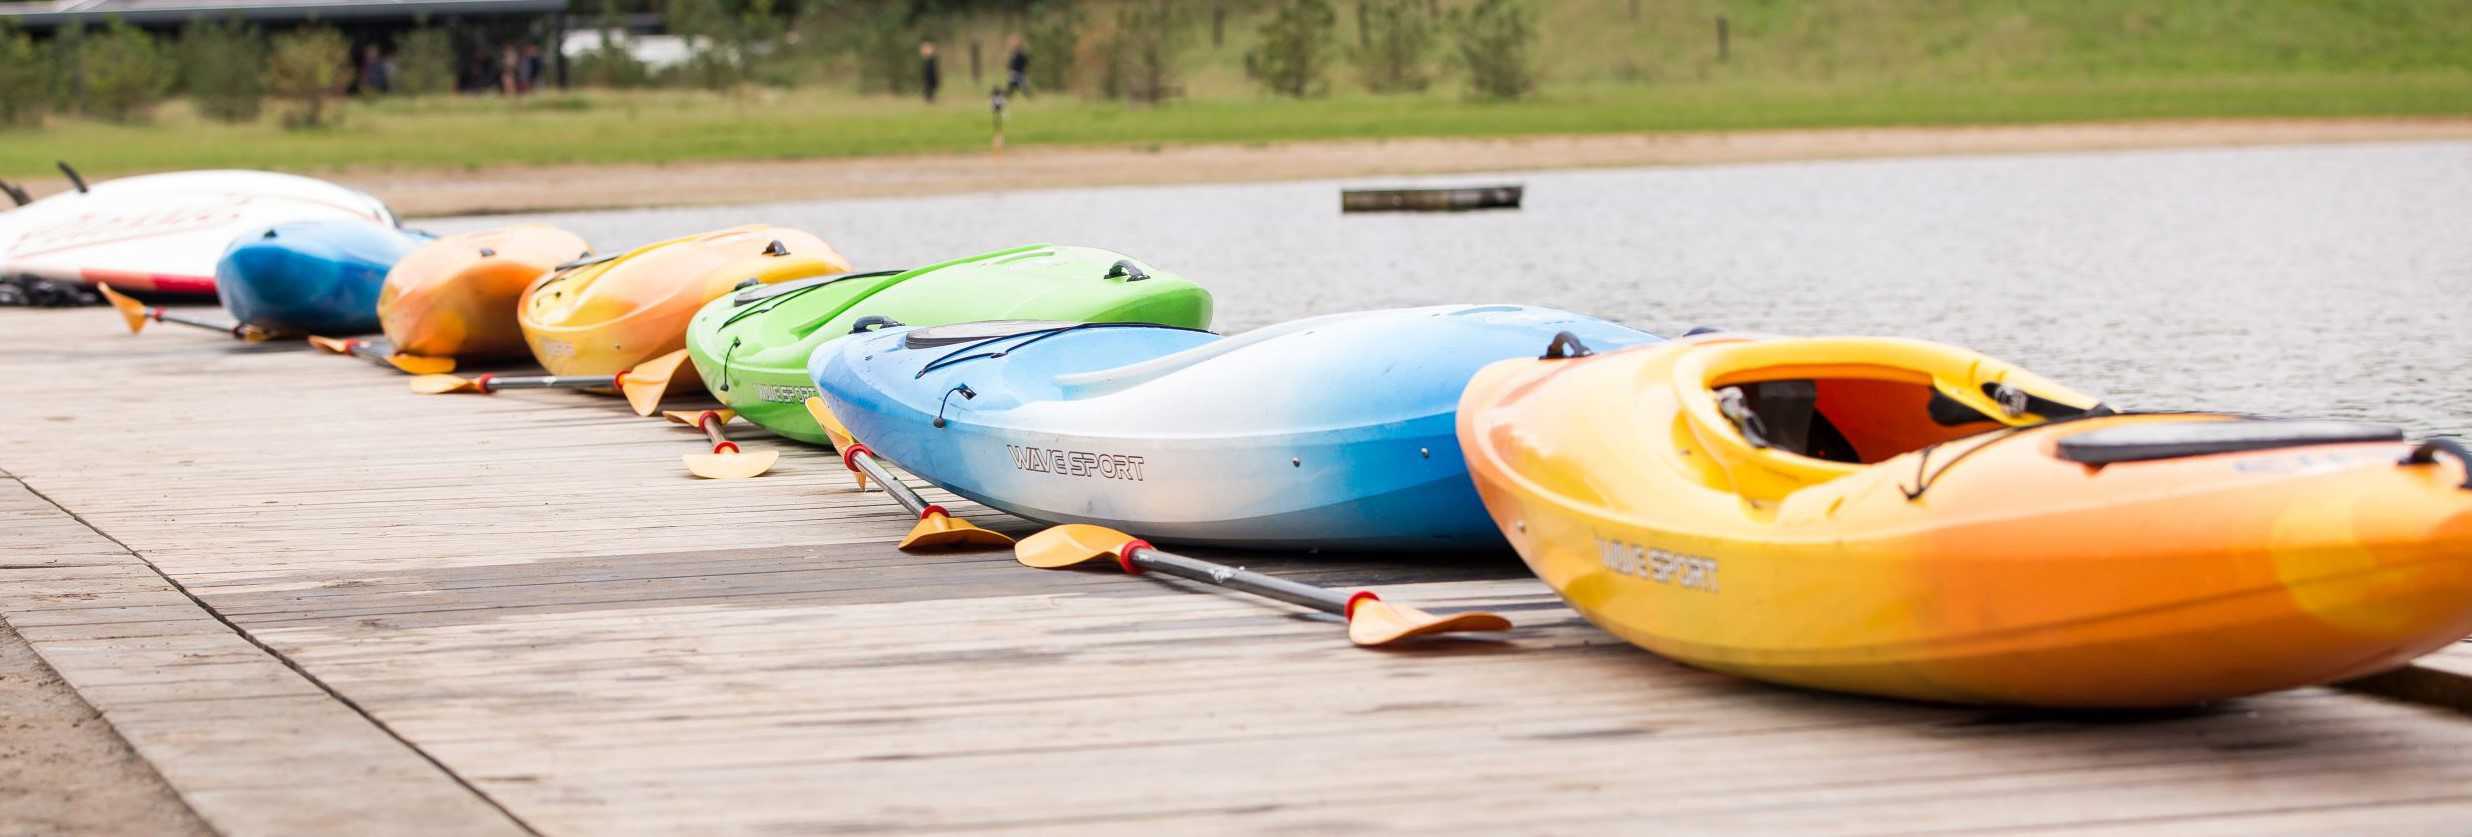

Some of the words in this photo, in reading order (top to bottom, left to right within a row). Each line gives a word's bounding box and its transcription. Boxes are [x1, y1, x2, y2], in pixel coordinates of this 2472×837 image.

[1006, 444, 1068, 475] WAVE
[1068, 451, 1145, 481] SPORT
[1647, 546, 1719, 592] SPORT
